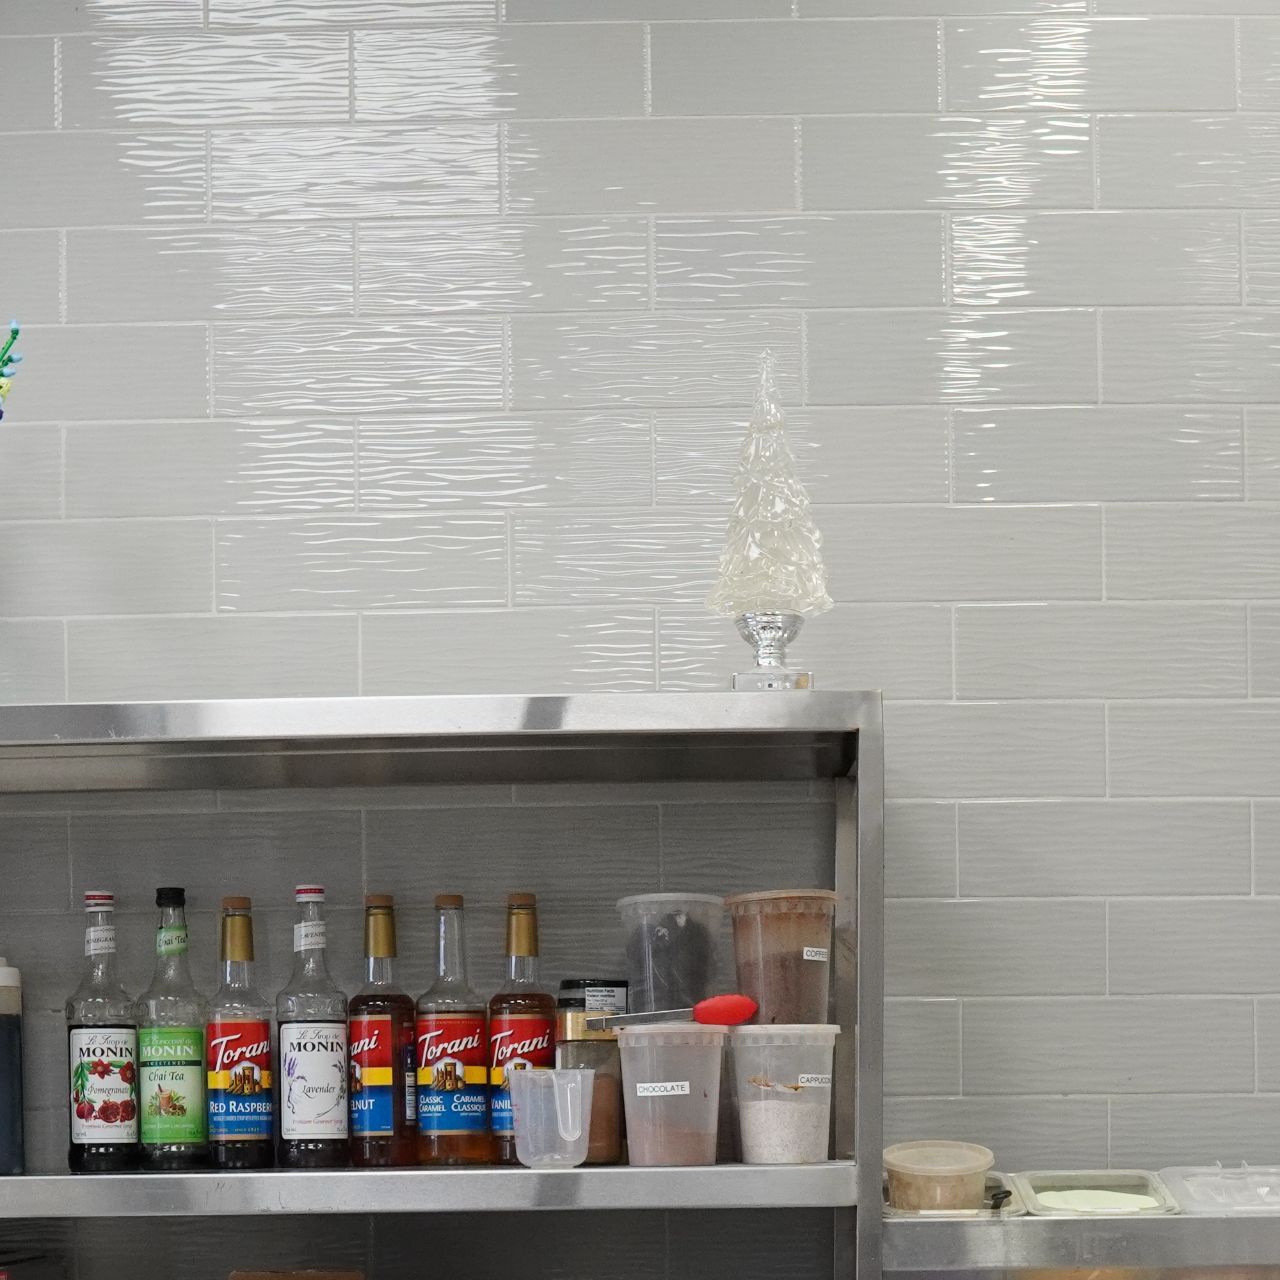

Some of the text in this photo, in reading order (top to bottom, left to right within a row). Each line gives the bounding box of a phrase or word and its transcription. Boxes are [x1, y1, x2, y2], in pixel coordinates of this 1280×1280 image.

[78, 1046, 133, 1058] MONIN
[142, 1046, 194, 1057] MONIN
[289, 1041, 344, 1053] MONIN
[418, 1028, 481, 1071] Torani
[491, 1028, 551, 1070] Torani
[148, 1069, 185, 1081] Chai Tea
[302, 1083, 337, 1099] Lavender
[639, 1084, 686, 1093] CHOCOLATE
[419, 1095, 444, 1104] CLASSIC
[453, 1094, 485, 1104] CARAMEL
[209, 1101, 226, 1113] RED
[419, 1103, 447, 1112] CARAMEL
[451, 1103, 487, 1113] CLASSIQUE
